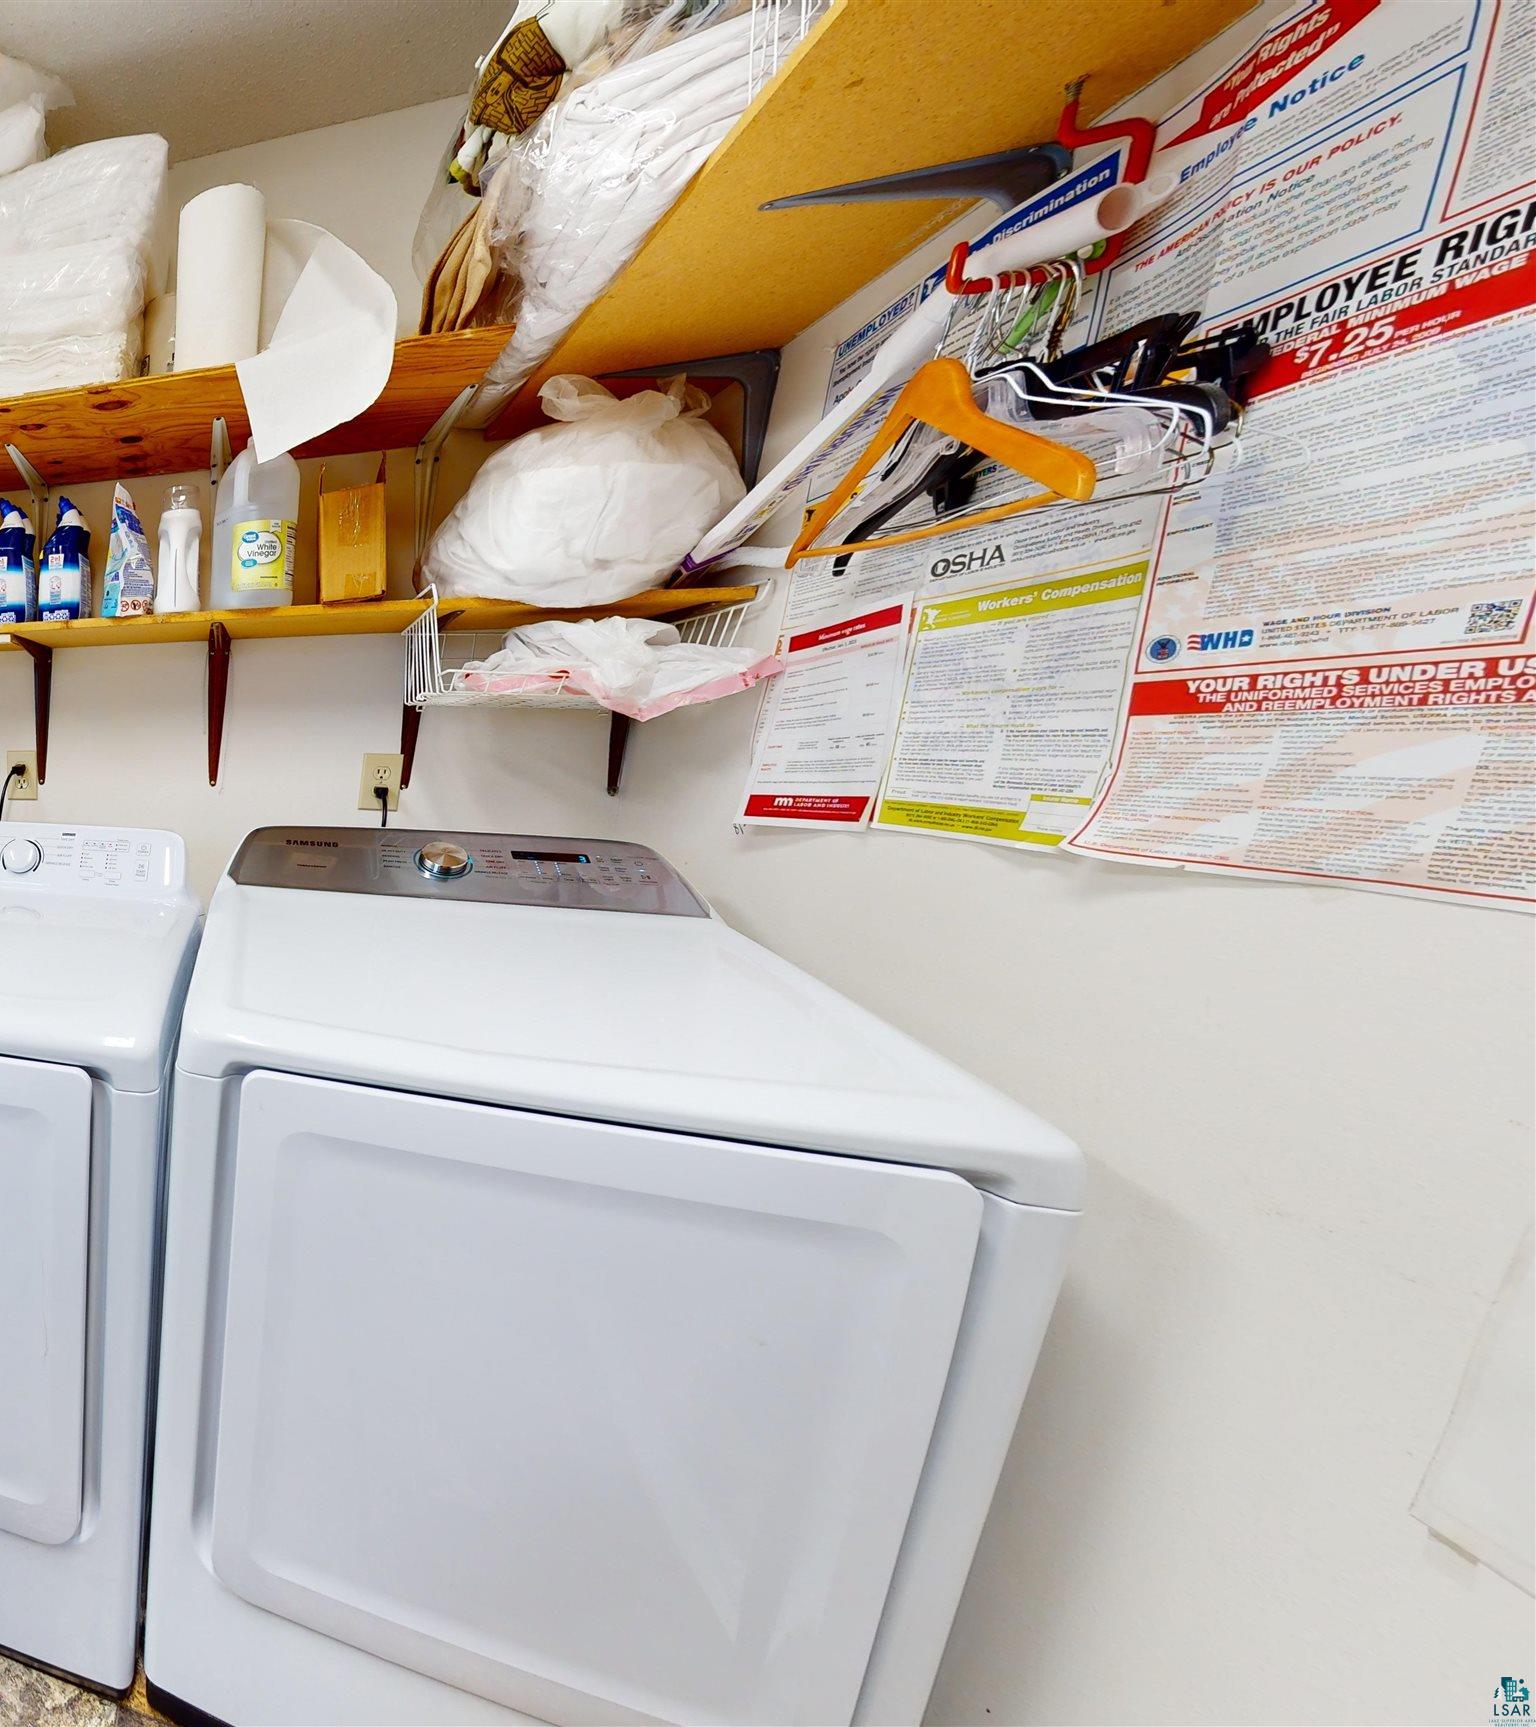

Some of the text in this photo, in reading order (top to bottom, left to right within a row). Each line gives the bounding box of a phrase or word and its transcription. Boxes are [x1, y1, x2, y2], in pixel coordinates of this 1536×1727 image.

[1258, 8, 1332, 64] Rights
[1178, 116, 1258, 184] Employee
[1268, 54, 1365, 119] Notice
[992, 167, 1111, 243] Discrimination
[1135, 254, 1155, 272] THE
[1259, 179, 1277, 195] IS
[1283, 155, 1323, 182] OUR
[1326, 111, 1403, 160] POLICY.
[1266, 174, 1316, 204] Notice
[1221, 247, 1424, 337] MPLOYEE
[1276, 322, 1308, 344] THE
[1310, 304, 1351, 330] FAIR
[1356, 276, 1424, 312] LABOR
[1346, 282, 1450, 330] MINIMUM
[1454, 251, 1530, 291] WAGE
[838, 291, 916, 358] UNEMPLOYED?
[1294, 314, 1398, 369] $7.25
[1393, 310, 1462, 340] PER HOUR
[246, 550, 277, 558] Vinegar
[256, 543, 277, 551] White
[930, 543, 1006, 578] OSHA
[977, 571, 1143, 613] Workers’ Compensation
[1198, 628, 1255, 652] WHD
[1329, 612, 1400, 628] DEPARTMENT
[1401, 610, 1418, 619] OF
[1419, 606, 1460, 618] LABOR
[1290, 615, 1311, 625] AND
[1343, 606, 1392, 619] DIVISION
[1186, 676, 1250, 693] YOUR
[1256, 669, 1361, 690] RIGHTS
[1368, 660, 1486, 684] UNDER
[1197, 675, 1536, 704] THE UNIFORMED SERVICES EMPLO
[1221, 701, 1258, 713] AND
[1261, 693, 1426, 712] REEMPLOYMENT
[1427, 690, 1518, 706] RIGHTS
[285, 838, 340, 848] SAMSUNG
